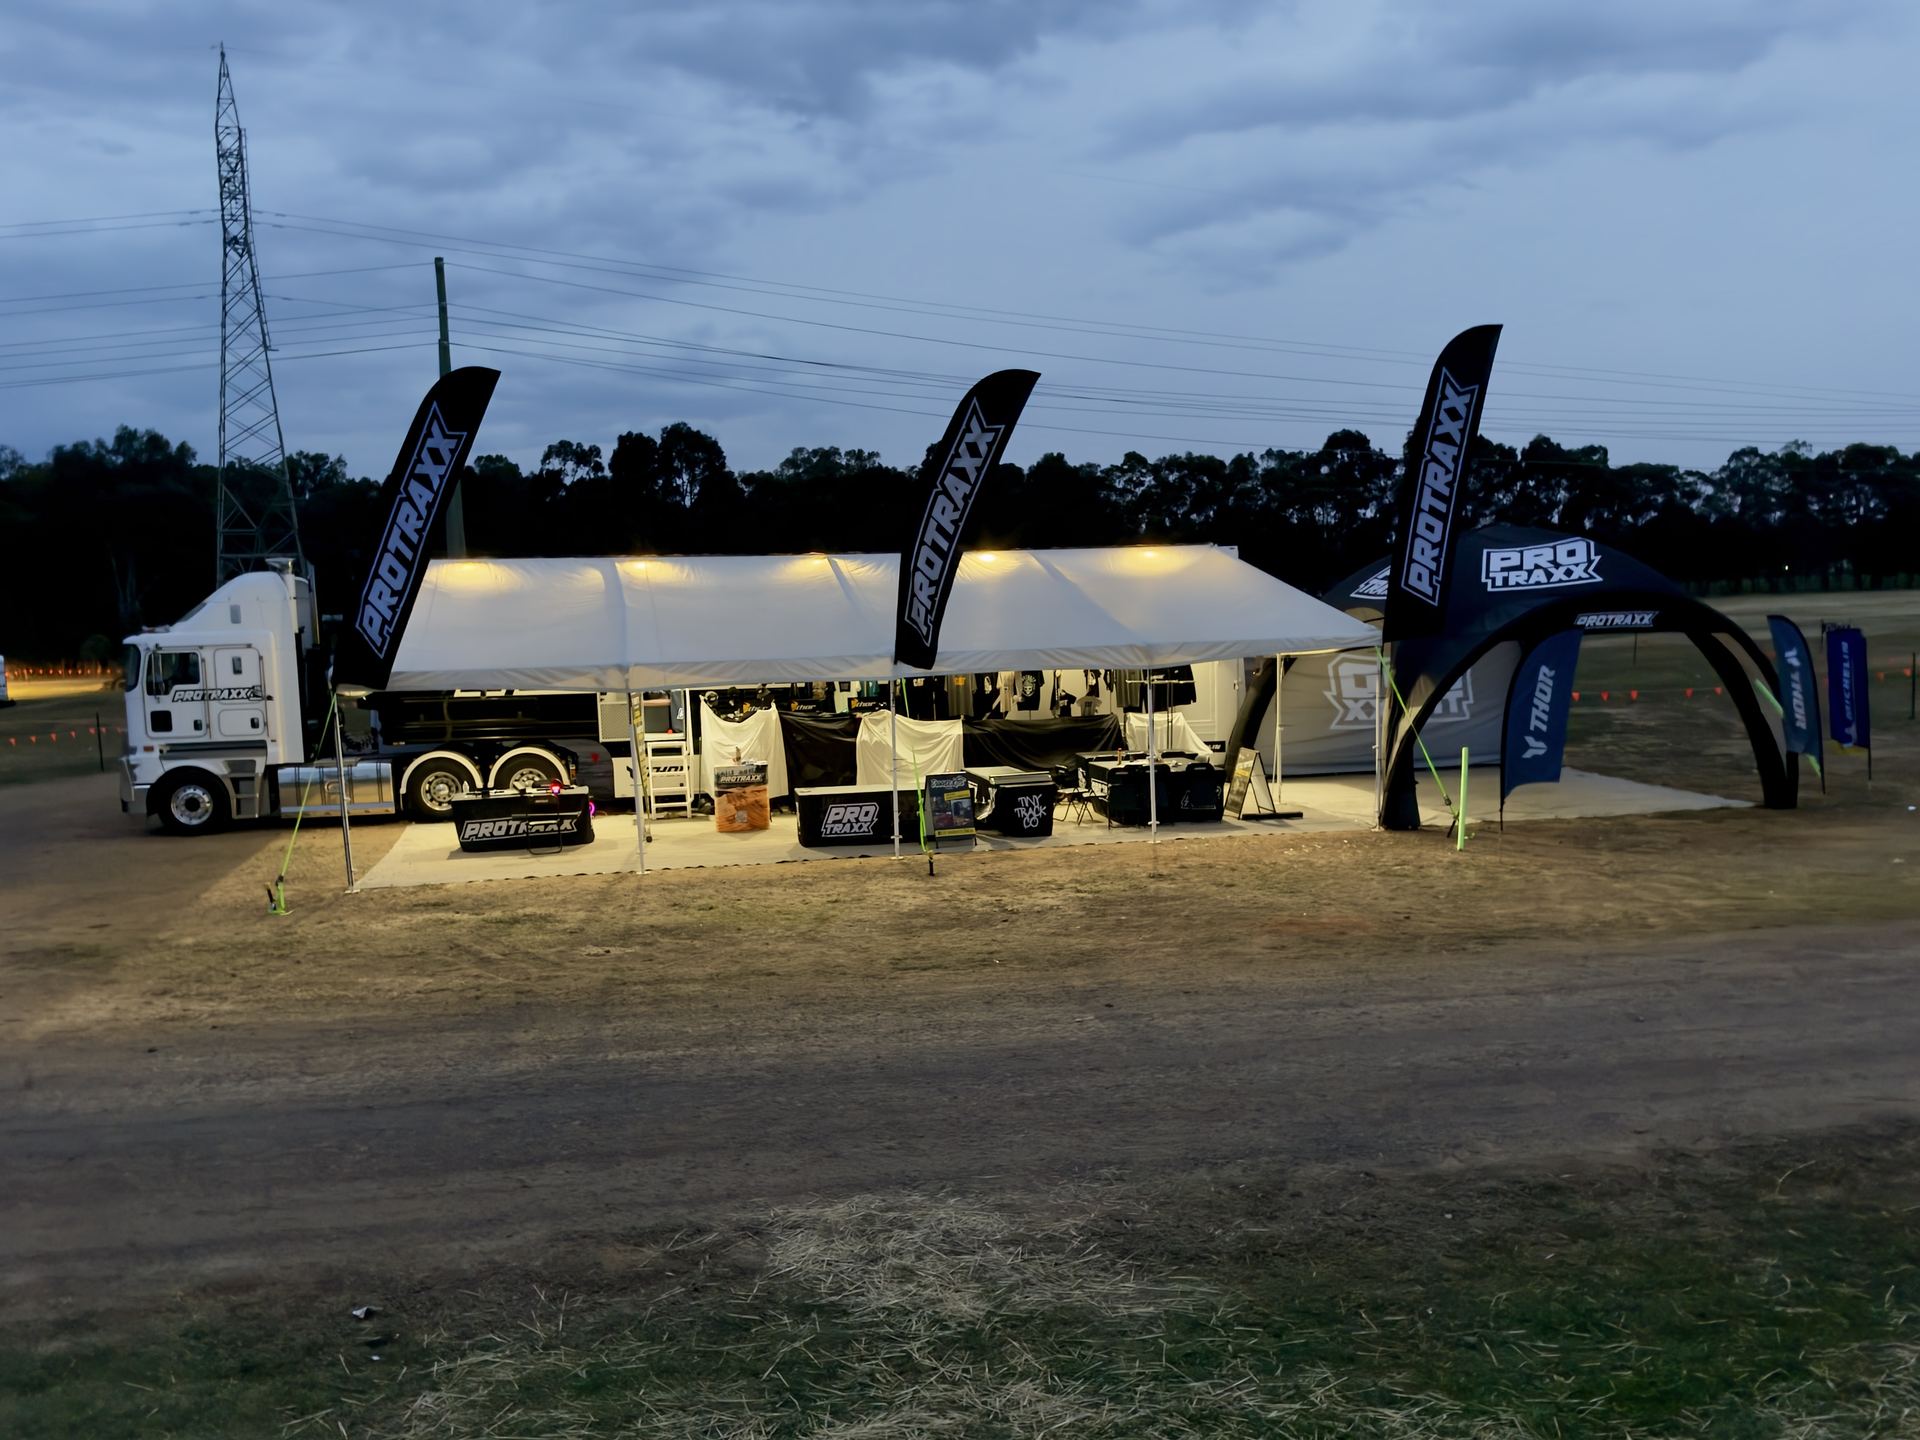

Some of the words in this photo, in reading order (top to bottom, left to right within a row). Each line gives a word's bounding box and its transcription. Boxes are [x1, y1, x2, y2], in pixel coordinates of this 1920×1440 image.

[1408, 382, 1471, 598] PROTRAXX
[361, 419, 459, 647] PROTRAXX
[911, 415, 995, 637] PROTRAXX
[1490, 540, 1587, 572] PRO
[1489, 562, 1590, 586] TRAXX
[1577, 613, 1653, 627] PROTRAXX
[173, 688, 248, 702] PROTRAXX
[1529, 664, 1556, 732] THOR
[1790, 671, 1807, 730] THOR
[720, 774, 762, 784] PROTRAXX
[1018, 794, 1042, 808] TINY
[826, 805, 876, 824] PRO
[1014, 806, 1047, 819] TRACK
[825, 822, 871, 834] TRAXX
[1023, 816, 1039, 829] CO
